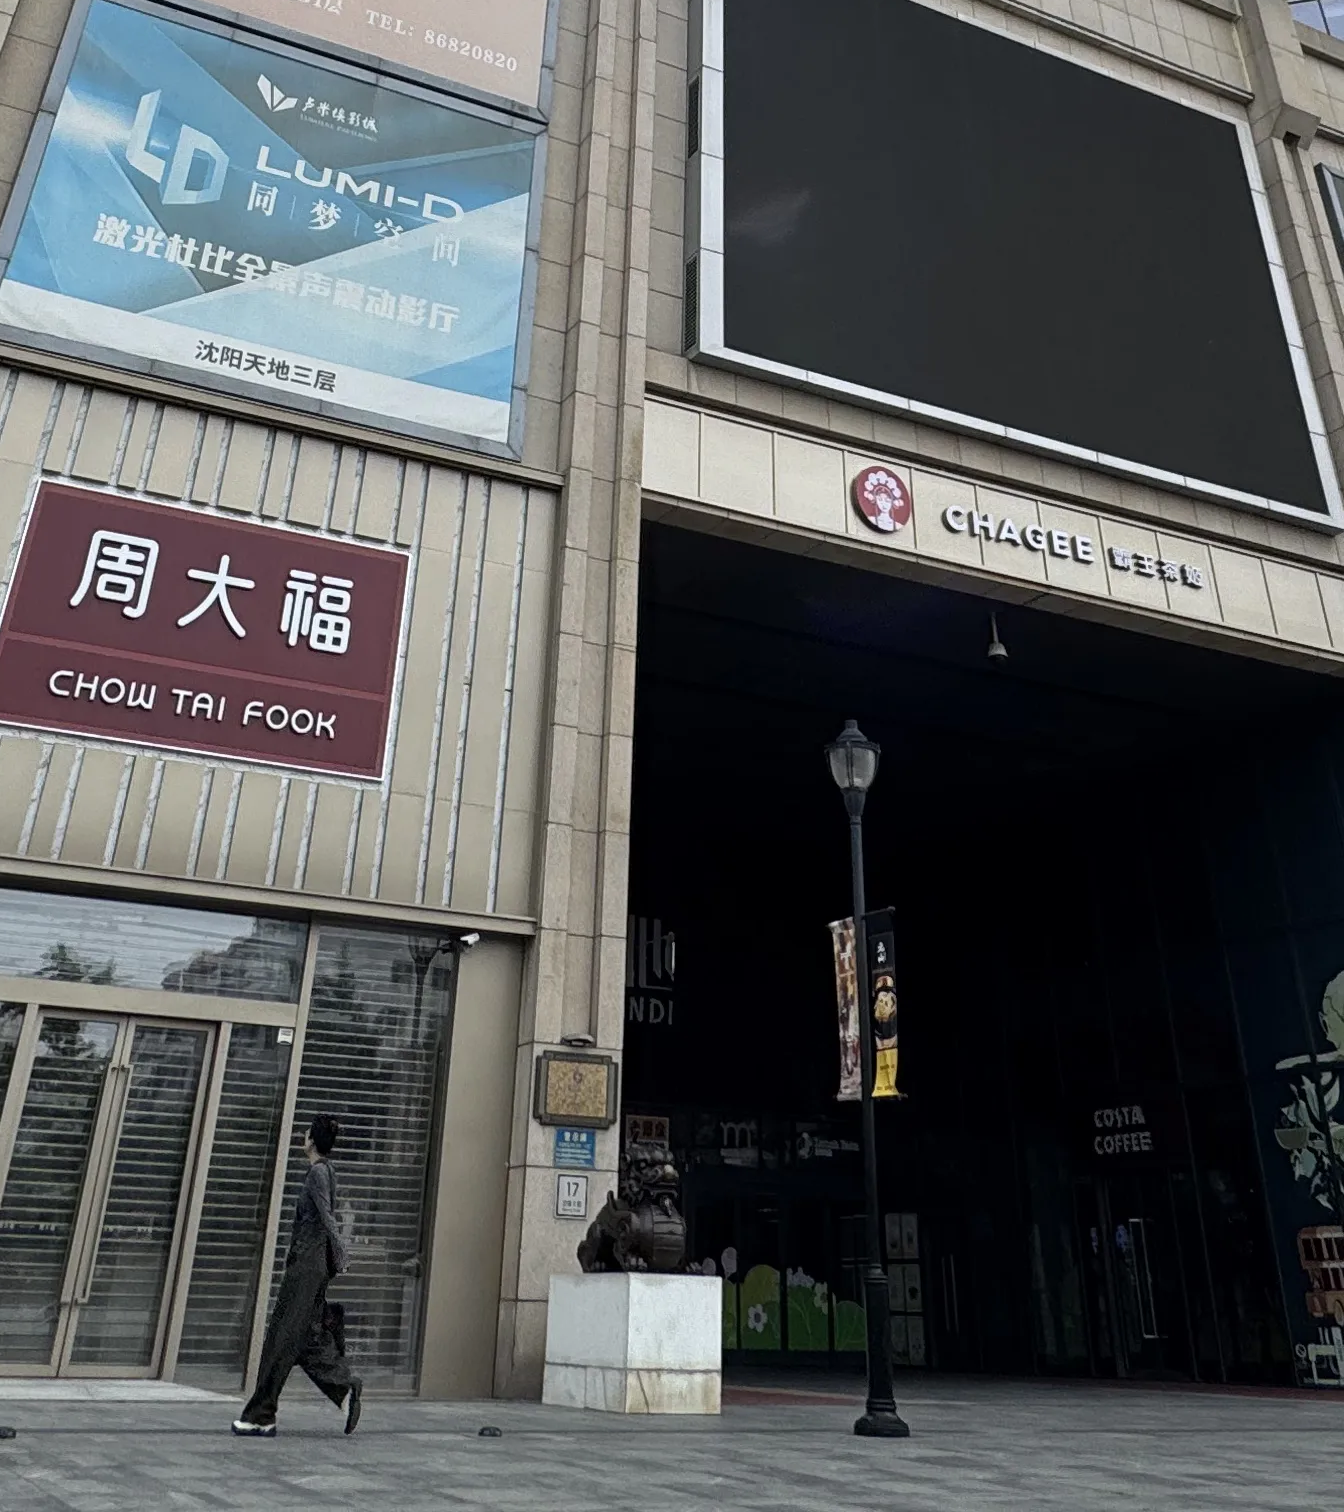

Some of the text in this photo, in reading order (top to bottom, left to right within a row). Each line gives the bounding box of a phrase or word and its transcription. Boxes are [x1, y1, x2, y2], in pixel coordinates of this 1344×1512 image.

[423, 29, 518, 72] 86820820
[256, 145, 465, 223] LUMI-D
[92, 212, 460, 334] 激光杜比全景声震动影厅
[195, 339, 338, 394] 沈阳天地三层
[942, 504, 1095, 564] CHAGEE
[68, 529, 355, 655] 周大福
[48, 670, 338, 740] CHOW TAI FOOK
[1093, 1104, 1146, 1128] COSTA
[1093, 1130, 1154, 1155] COFFEE
[566, 1181, 579, 1197] 17
